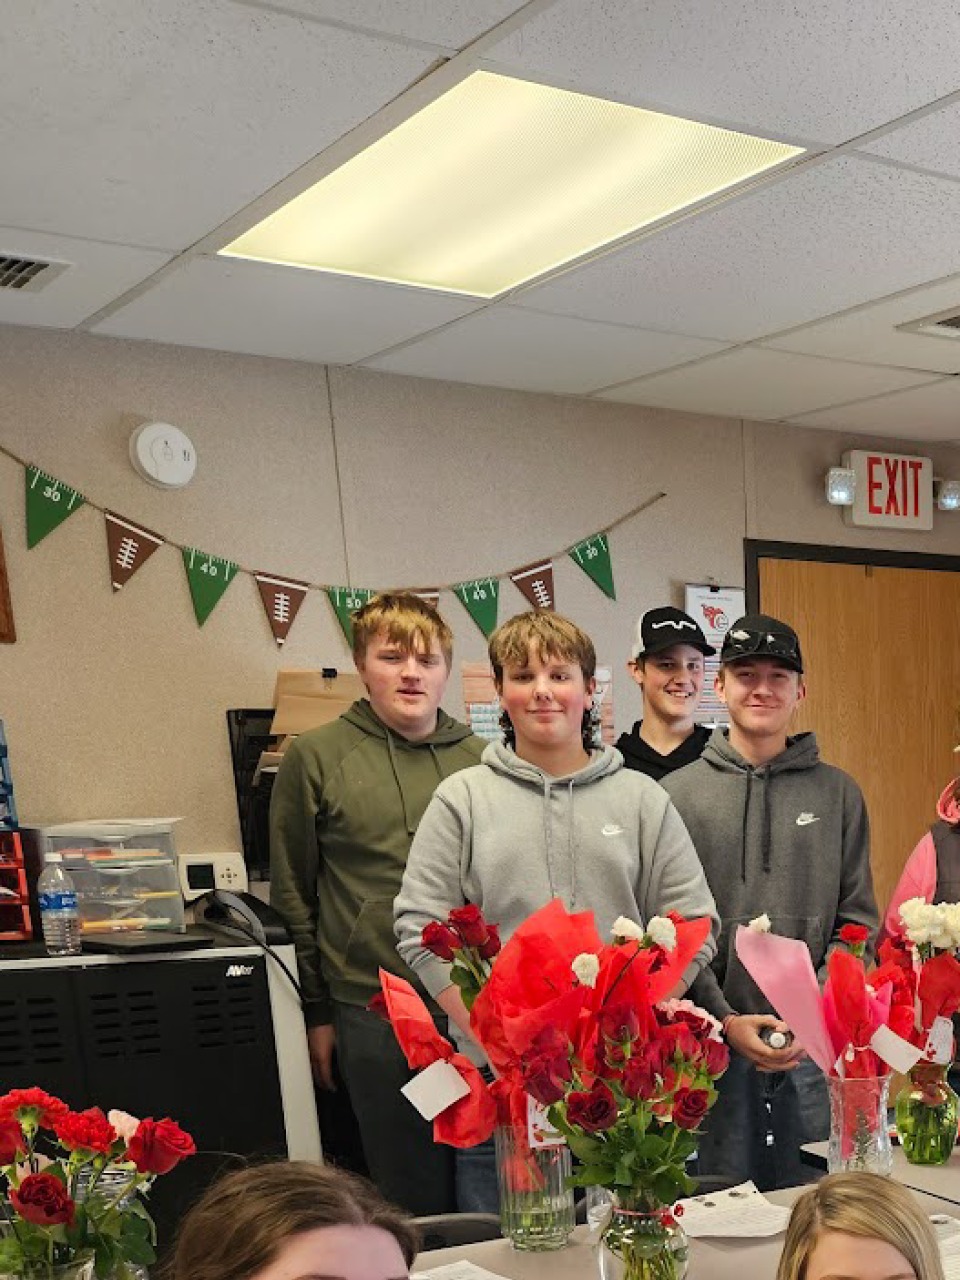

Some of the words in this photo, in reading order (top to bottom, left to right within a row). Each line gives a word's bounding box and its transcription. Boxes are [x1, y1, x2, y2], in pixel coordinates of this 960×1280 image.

[43, 485, 61, 502] 30
[867, 456, 922, 517] EXIT
[200, 562, 218, 577] 40
[345, 597, 362, 609] 50
